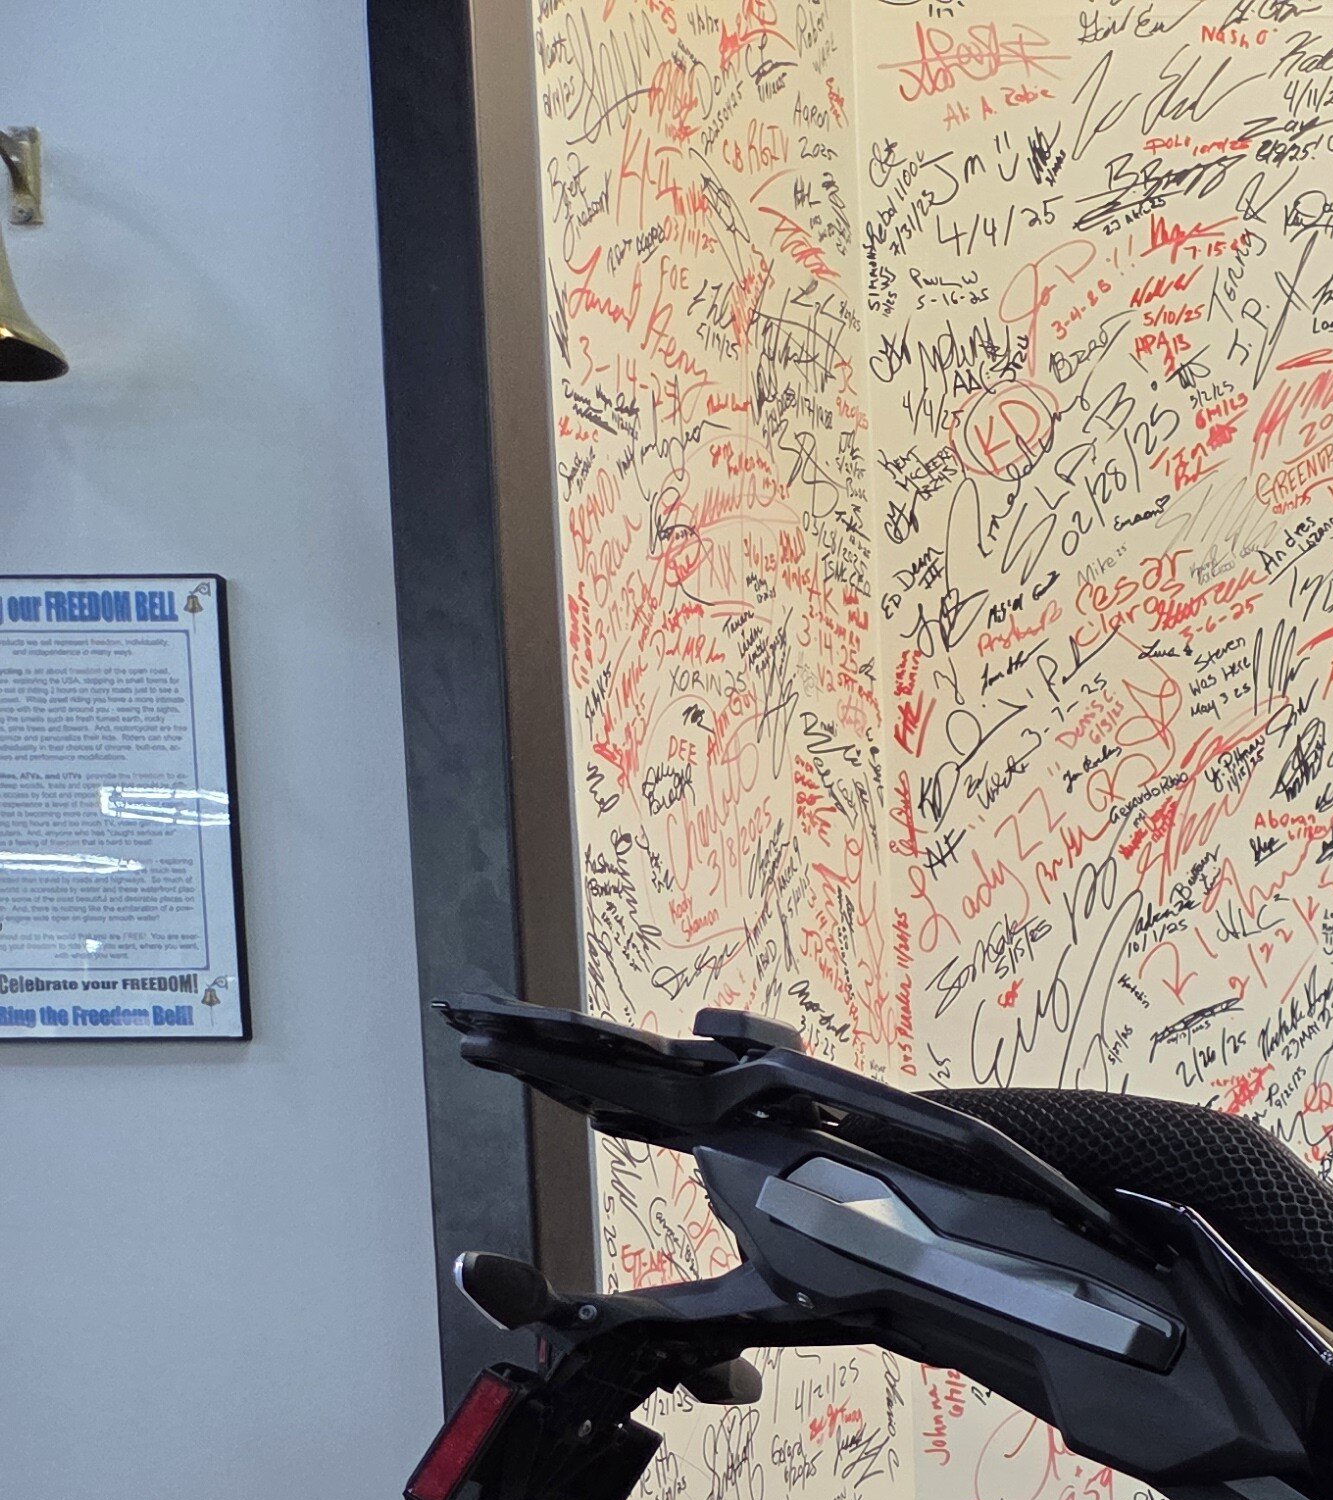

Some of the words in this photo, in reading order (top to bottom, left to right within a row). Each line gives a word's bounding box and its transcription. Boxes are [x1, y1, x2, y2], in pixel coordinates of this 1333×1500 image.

[7, 596, 42, 622] our
[44, 591, 132, 622] FREEDOM
[135, 591, 179, 622] BELL
[0, 974, 78, 994] Celebrate
[81, 979, 118, 990] your
[122, 973, 199, 994] FREEDOM!
[72, 1006, 149, 1026] Freedom
